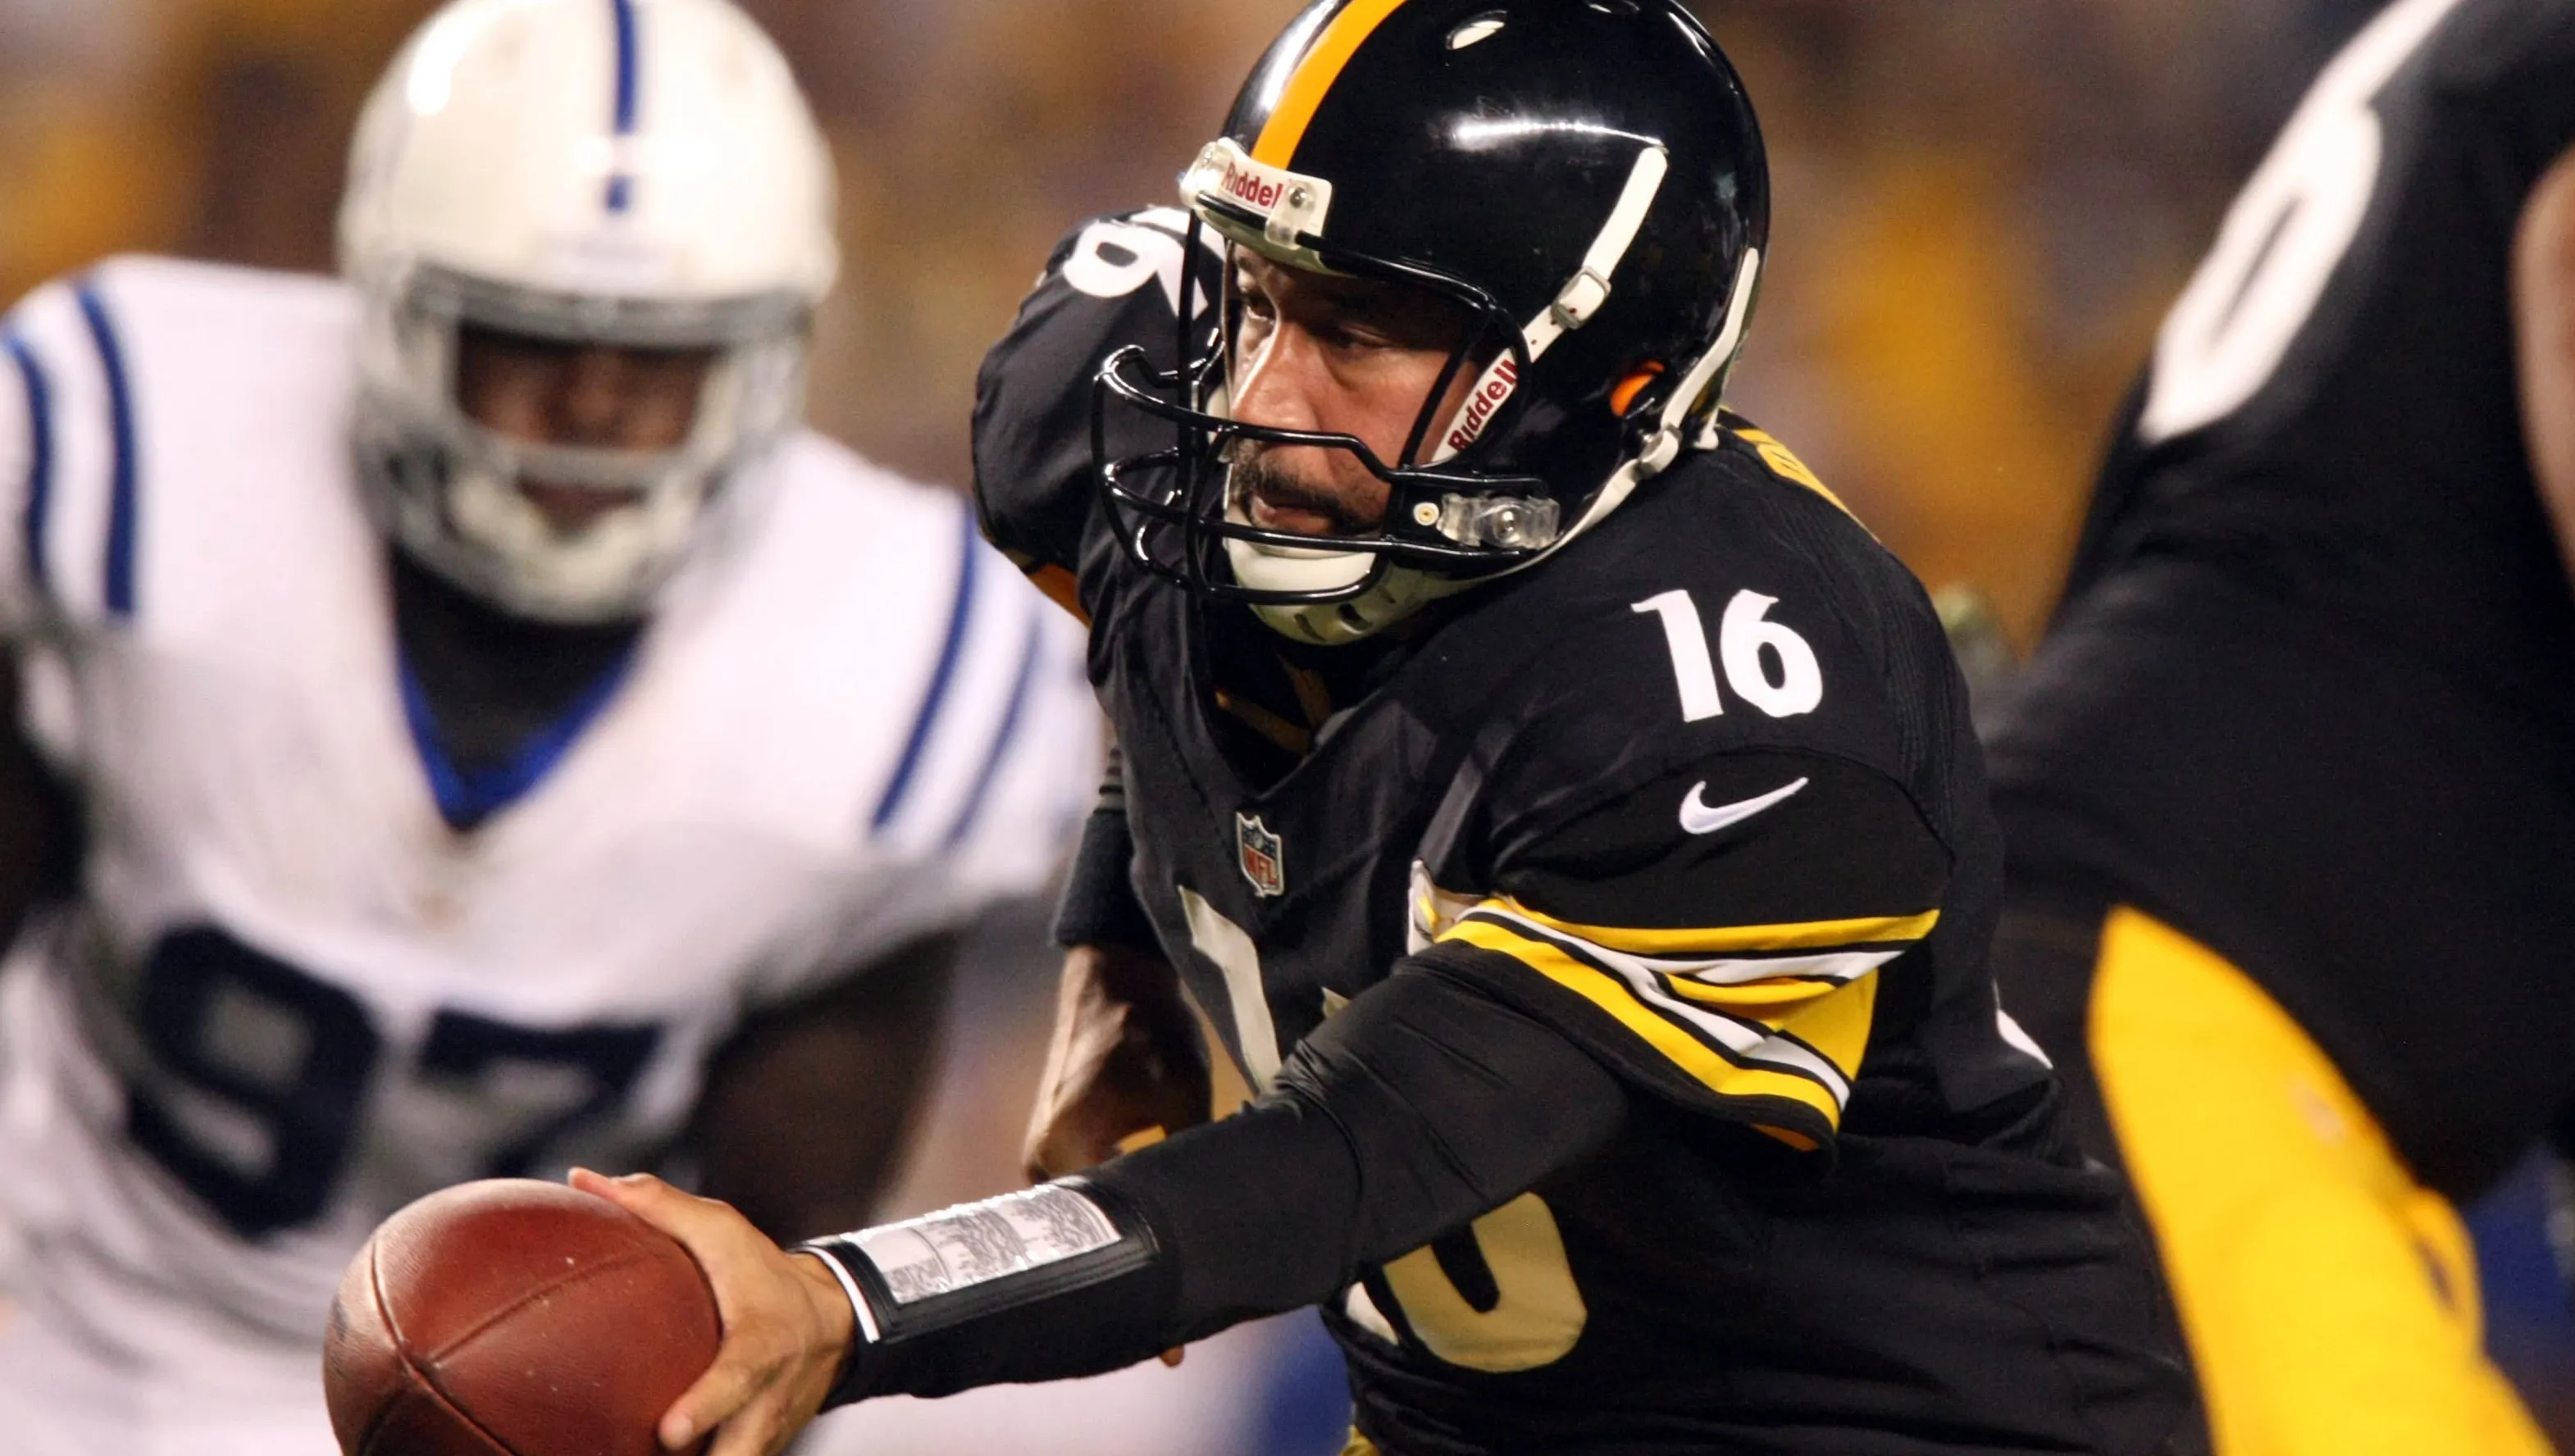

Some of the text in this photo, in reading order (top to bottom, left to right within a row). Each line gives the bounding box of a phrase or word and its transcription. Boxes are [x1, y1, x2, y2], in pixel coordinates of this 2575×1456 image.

[1222, 162, 1285, 210] Riddel
[1447, 359, 1517, 451] Riddell
[1630, 588, 1823, 722] 16
[128, 922, 666, 1243] 97
